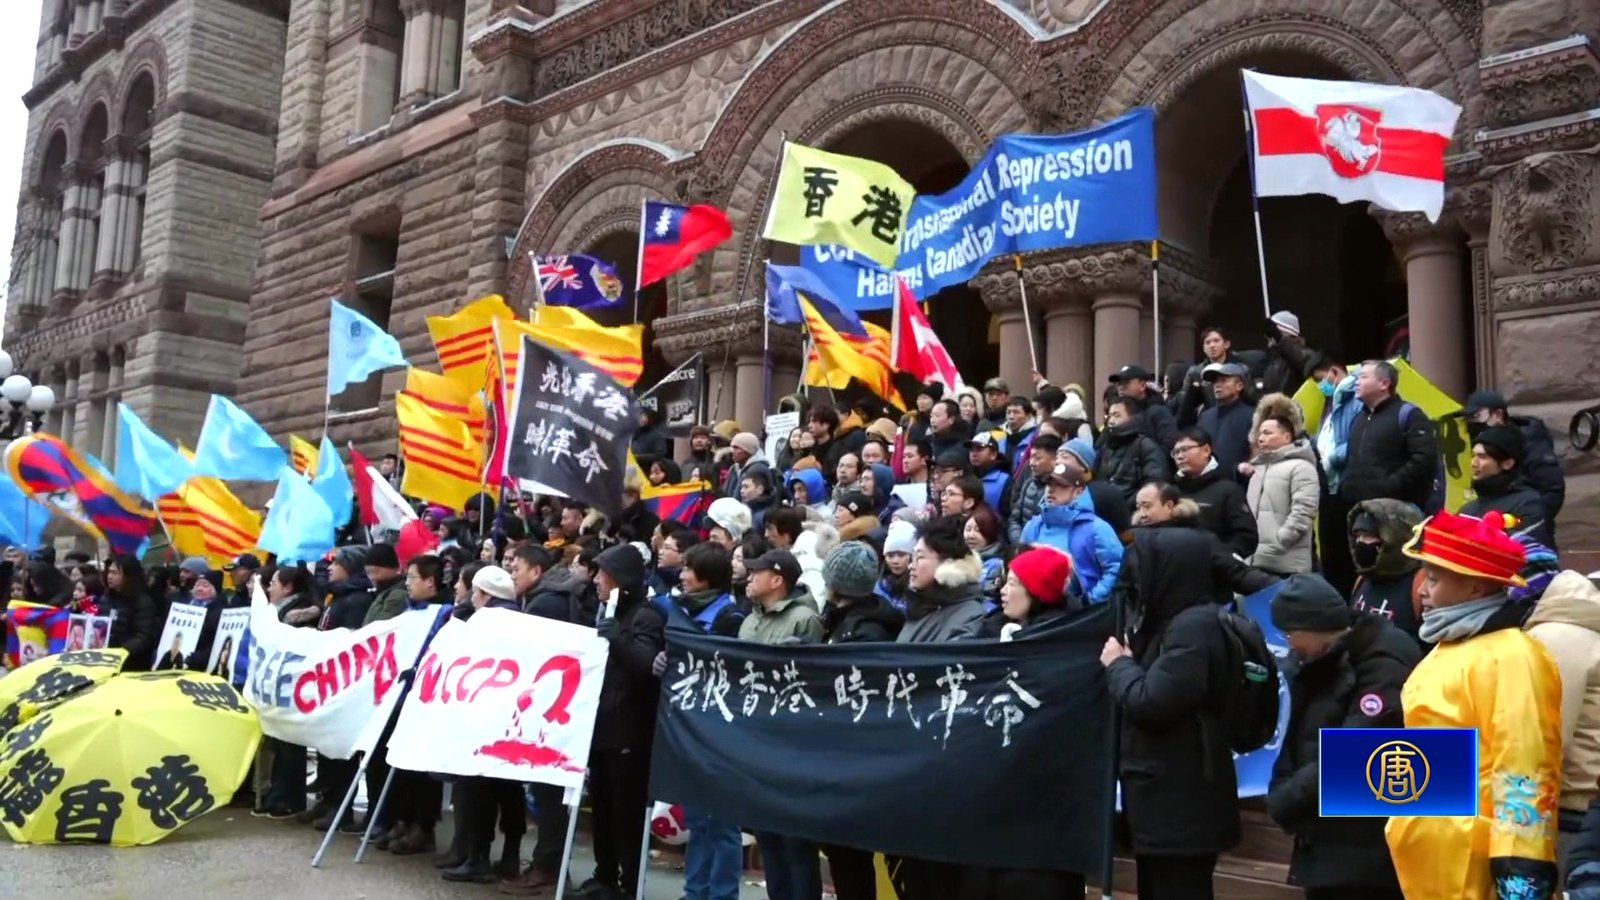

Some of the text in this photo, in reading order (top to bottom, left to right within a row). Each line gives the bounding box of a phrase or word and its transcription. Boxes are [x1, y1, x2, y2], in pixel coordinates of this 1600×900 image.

[996, 139, 1133, 195] Repression
[803, 166, 902, 245] 香港
[1001, 192, 1080, 239] Society
[249, 634, 308, 707] REE
[294, 632, 399, 714] CHINA
